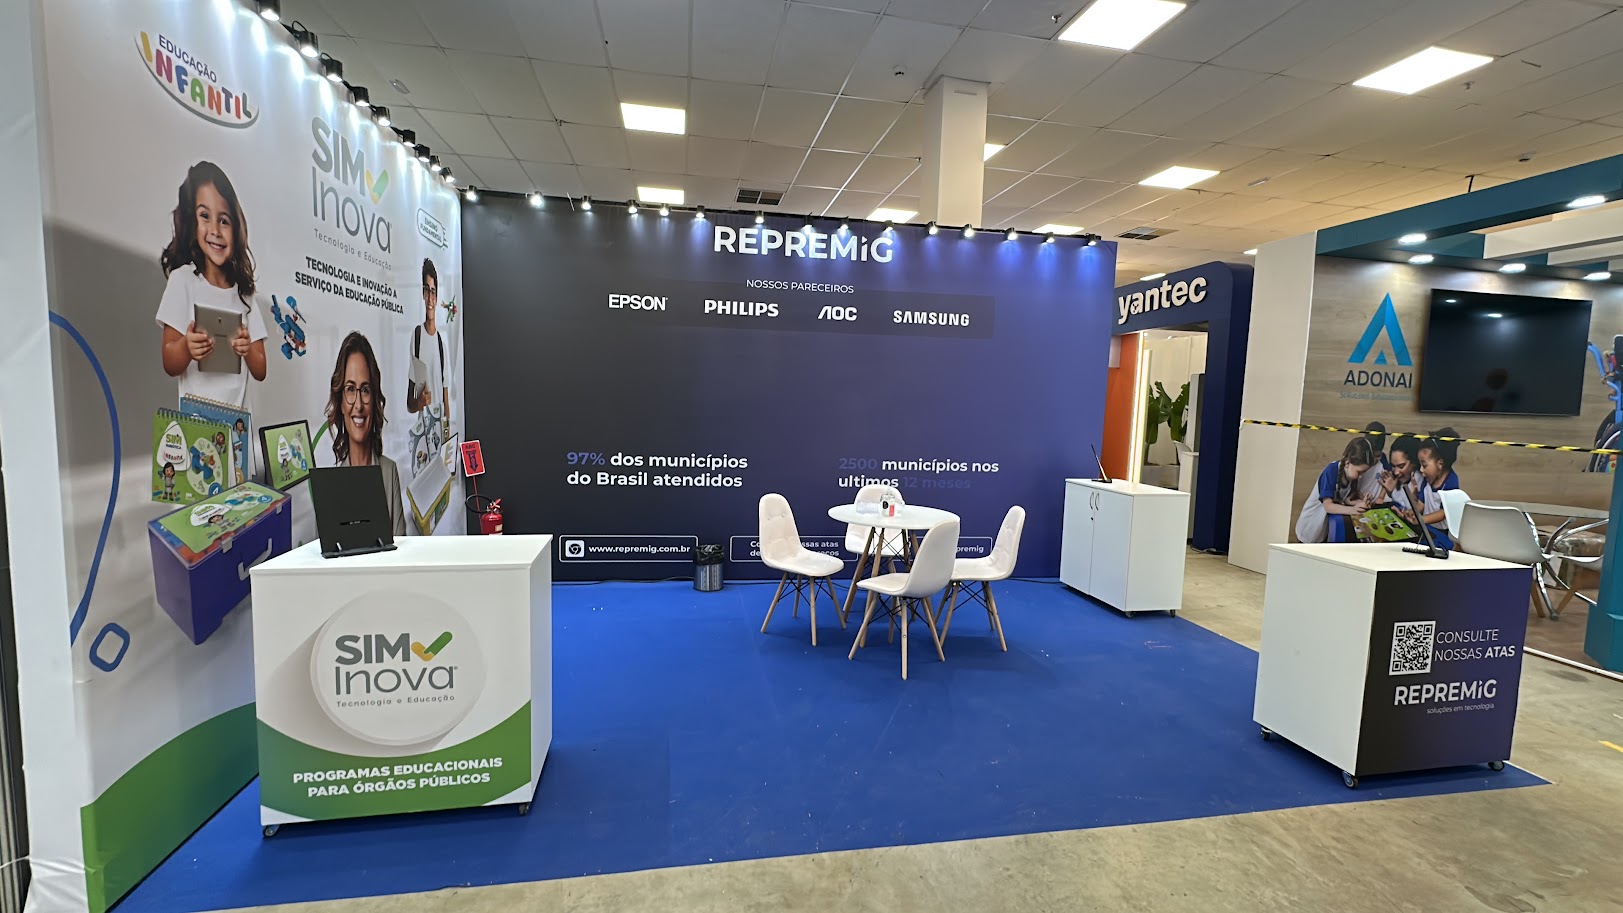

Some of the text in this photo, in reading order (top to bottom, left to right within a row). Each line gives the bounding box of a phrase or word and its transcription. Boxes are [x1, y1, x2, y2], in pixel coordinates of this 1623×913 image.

[158, 34, 217, 83] EDUCAÇÃO
[140, 32, 252, 120] INFANTIL
[312, 116, 366, 196] SIM
[312, 166, 391, 254] Inova
[314, 228, 354, 254] Tecnologia
[364, 252, 392, 270] Educação
[306, 256, 397, 298] TECNOLOGIA E INOVAÇÃO A
[295, 271, 404, 314] SERVIÇO DA EDUCAÇÃO PÚBLICA
[746, 279, 854, 294] NOSSOS PARECEIROS
[608, 294, 667, 311] EPSON
[704, 300, 780, 318] PHILIPS
[1118, 276, 1207, 324] yantec
[818, 306, 858, 321] AOC
[893, 310, 970, 327] SAMSUNG
[1344, 370, 1412, 388] ADONAI
[566, 452, 748, 470] 97% dos municípios
[839, 458, 999, 474] 2500 municípios nos
[566, 471, 742, 487] do Brasil atendidos
[903, 477, 917, 488] 12
[922, 478, 971, 488] meses
[588, 544, 690, 554] www.repremig.com.br
[1436, 629, 1499, 644] CONSULTE
[334, 633, 410, 666] SIM
[1434, 646, 1516, 662] NOSSAS ATAS
[336, 666, 454, 696] Inova
[336, 699, 392, 708] Tecnologia
[407, 695, 455, 703] Educação
[1427, 706, 1452, 715] soluções
[1464, 703, 1495, 711] tecnologia
[293, 757, 503, 784] PROGRAMAS EDUCACIONAIS
[308, 772, 490, 798] PARA ÓRGÃOS PÚBLICOS
